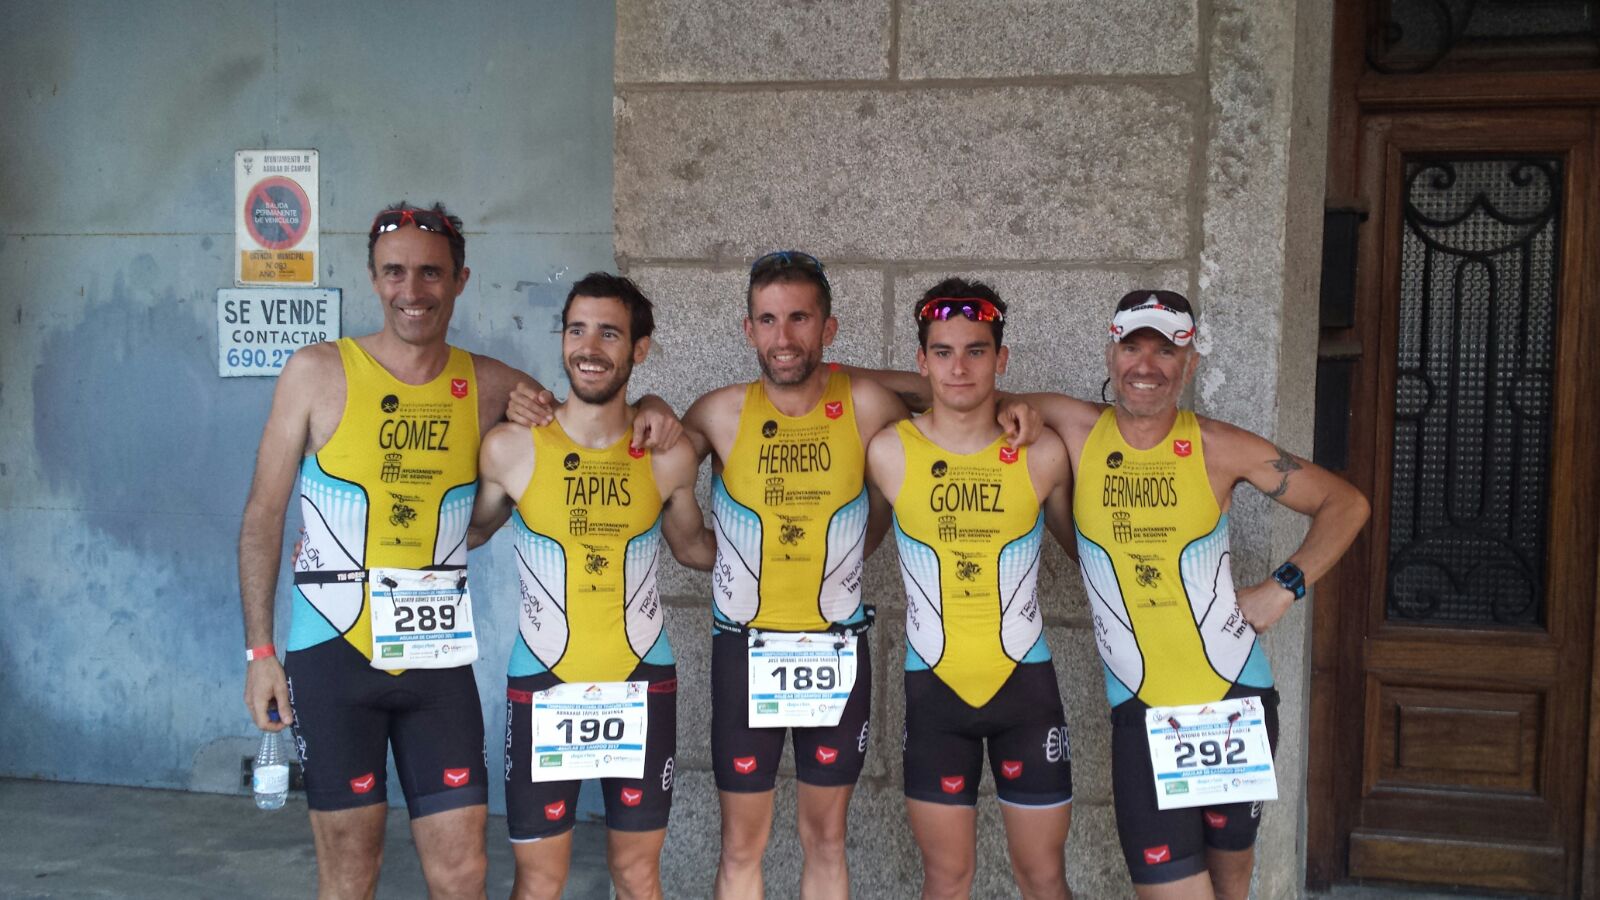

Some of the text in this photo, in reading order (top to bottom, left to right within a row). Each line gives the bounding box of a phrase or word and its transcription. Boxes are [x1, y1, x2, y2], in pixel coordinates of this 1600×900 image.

[255, 208, 297, 216] PERMANENTE
[277, 252, 305, 261] MUNICIPAL
[224, 299, 328, 325] SE VENDE
[232, 329, 327, 344] CONTACTAR
[379, 419, 450, 451] GOMEZ
[757, 441, 831, 474] HERRERO
[563, 477, 631, 507] TAPIAS
[930, 482, 1005, 513] GOMEZ
[1103, 474, 1177, 508] BERNARDOS
[394, 604, 456, 633] 289
[771, 666, 836, 691] 189
[556, 717, 625, 744] 190
[1174, 737, 1248, 769] 292
